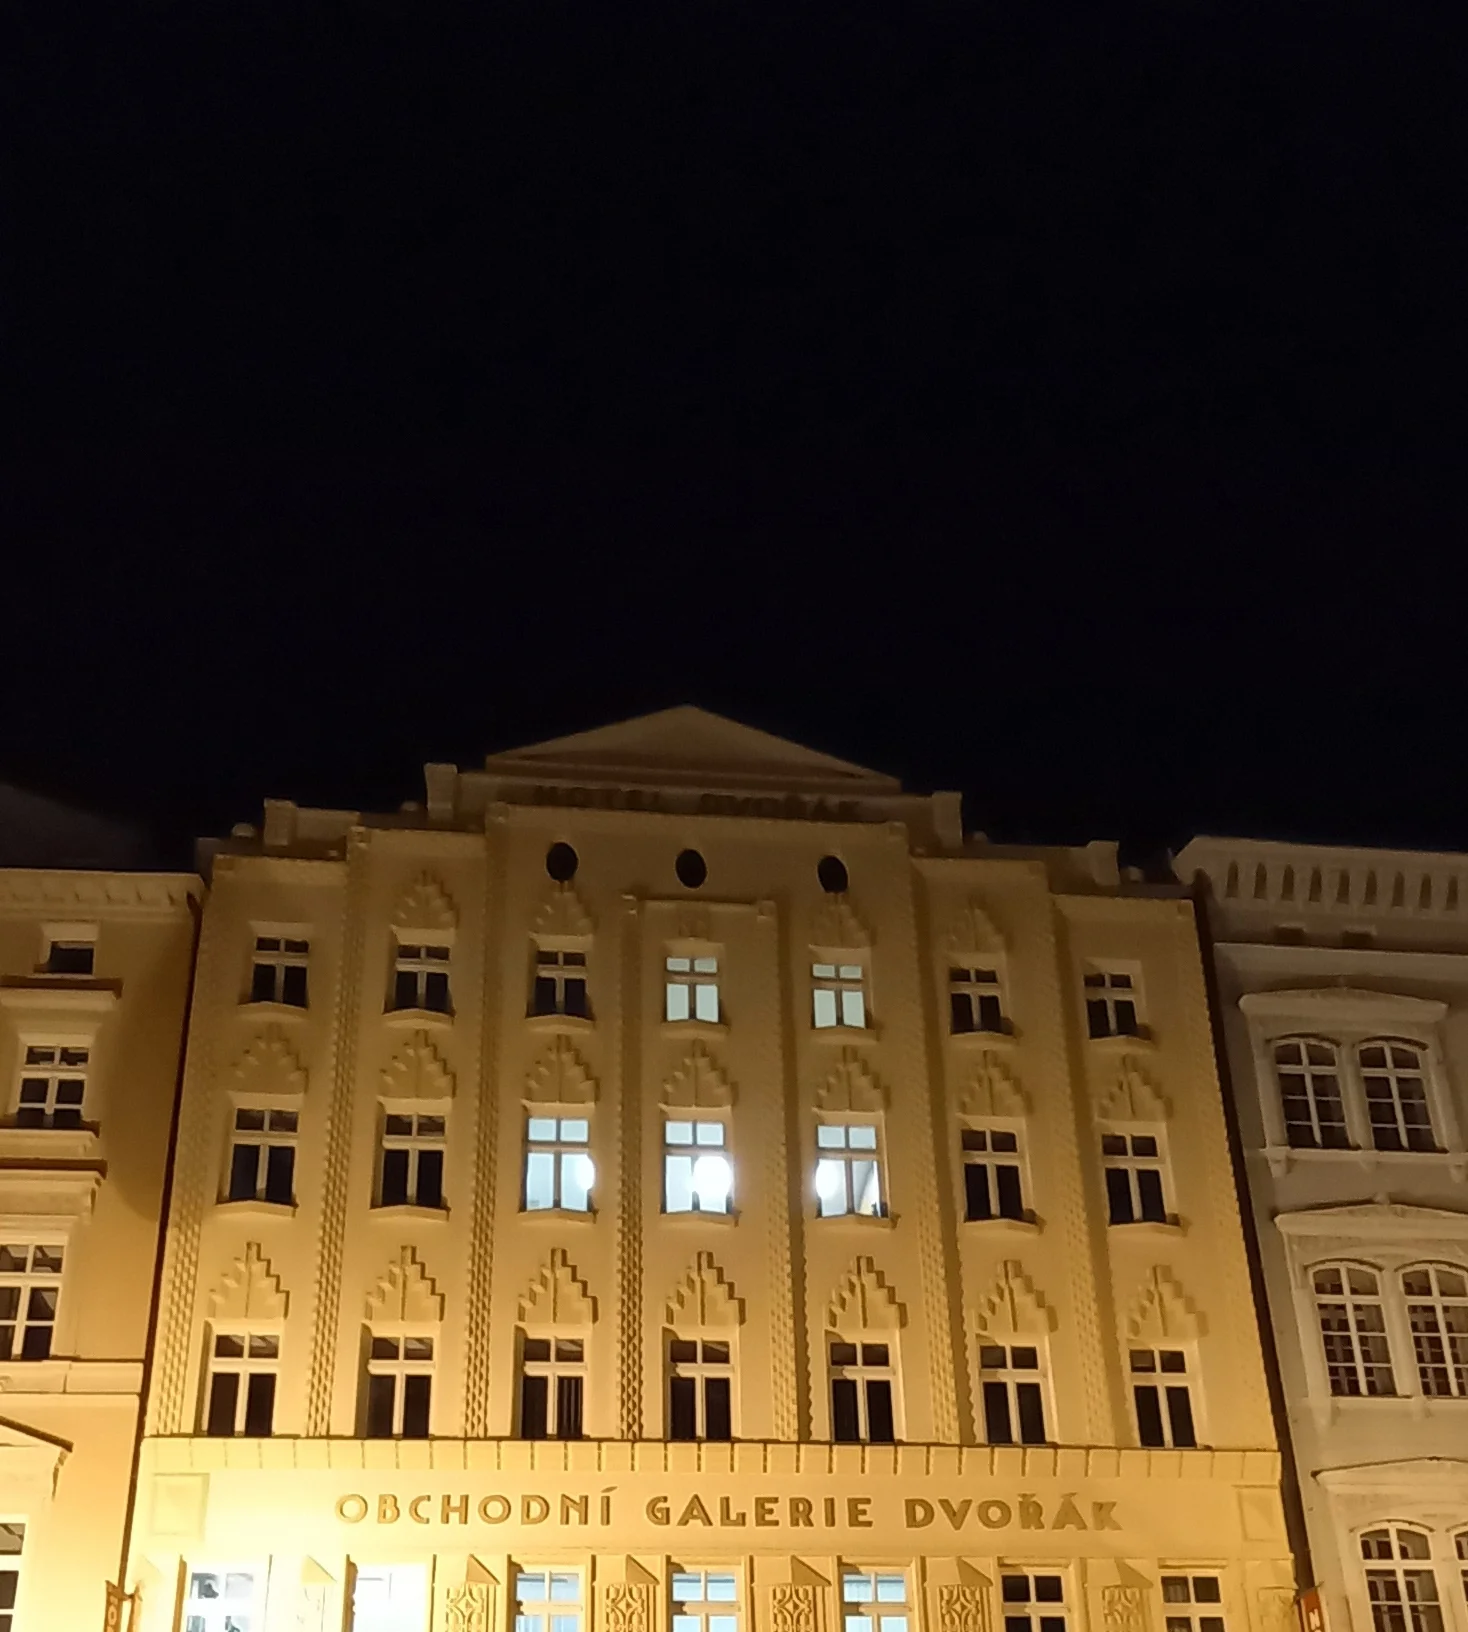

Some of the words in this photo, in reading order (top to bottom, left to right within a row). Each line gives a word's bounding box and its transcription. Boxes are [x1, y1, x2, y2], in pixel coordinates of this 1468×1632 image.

[334, 1486, 618, 1526] OBCHODNÍ
[645, 1495, 874, 1528] GALERIE
[904, 1491, 1123, 1531] DVOŘÁK
